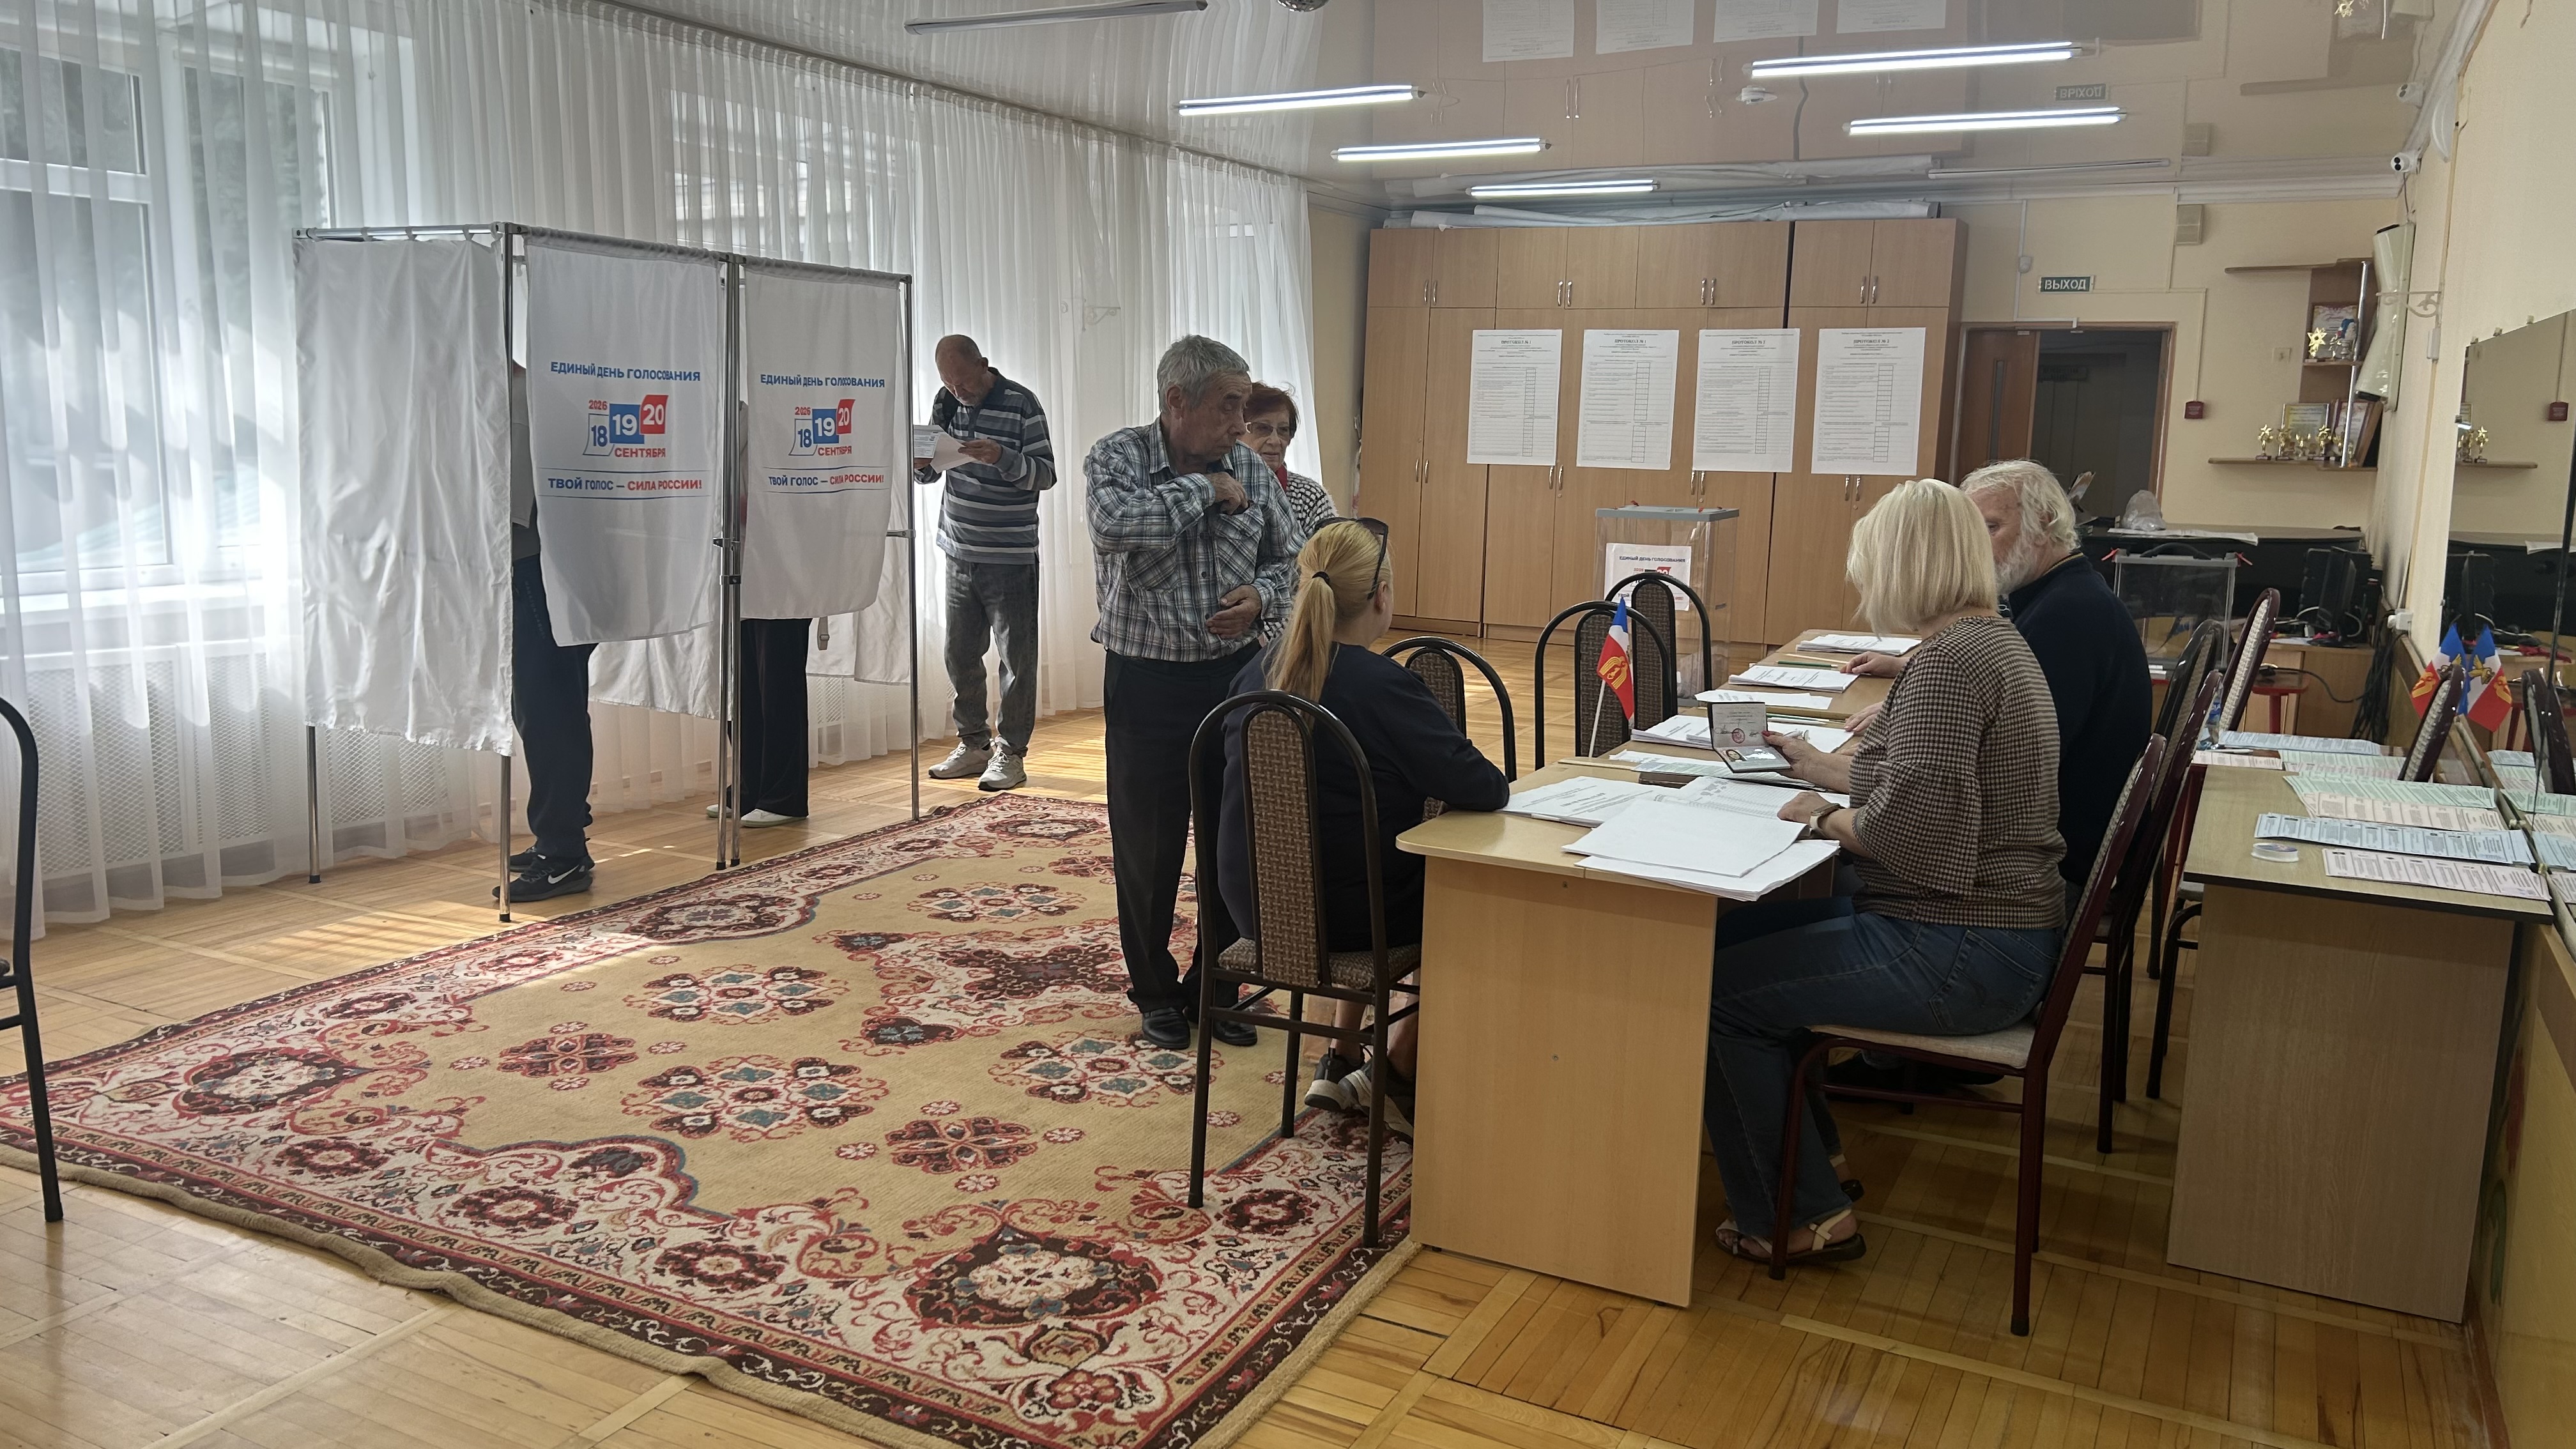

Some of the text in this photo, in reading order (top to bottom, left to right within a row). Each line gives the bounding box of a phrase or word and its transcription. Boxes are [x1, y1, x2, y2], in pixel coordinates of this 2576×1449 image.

[2044, 279, 2086, 290] ВЫХОД
[551, 362, 701, 381] ЕДИНЫЙ ДЕНЬ ГОЛОСОВАНИЯ
[760, 374, 801, 386] ЕДИНЫЙ
[802, 377, 823, 387] ДЕНЬ
[588, 399, 608, 410] 2026
[591, 404, 664, 447] 18 19 20
[797, 408, 850, 447] 18 19 20
[615, 448, 666, 457] СЕНТЯБРЯ
[548, 477, 582, 489] ТВОЙ
[585, 479, 614, 490] ГОЛОС
[627, 480, 657, 491] СИЛА
[658, 479, 702, 490] РОССИИ!
[769, 475, 788, 486] ТВОЙ
[790, 476, 818, 486] ГОЛОС
[830, 475, 844, 485] СИЛА
[845, 474, 884, 483] РОССИИ!
